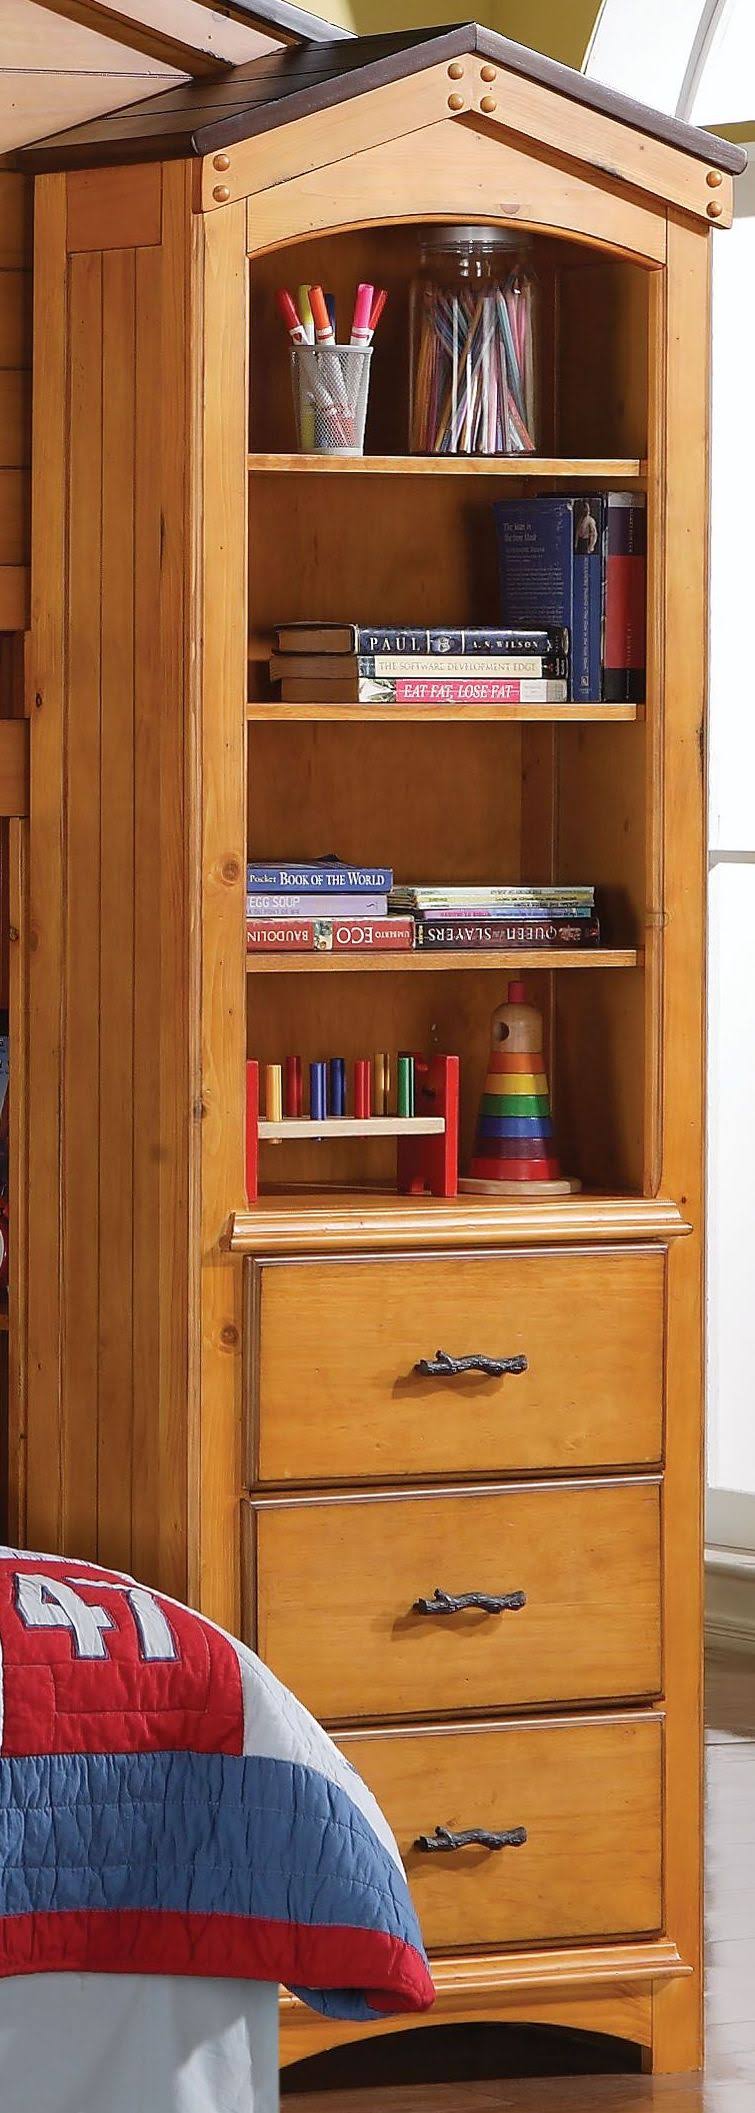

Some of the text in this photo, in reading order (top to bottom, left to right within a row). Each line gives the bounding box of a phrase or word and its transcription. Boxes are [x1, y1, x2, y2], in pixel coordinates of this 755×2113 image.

[369, 637, 421, 651] PAUL
[496, 640, 538, 649] WILSON
[379, 661, 537, 671] THE SOFTWARE DEVELOPMENT EDGE
[403, 684, 427, 698] EAT
[457, 684, 490, 698] LOSE
[490, 684, 514, 698] FAT
[249, 872, 385, 885] Pocket BOOK OF THE WORLD
[249, 896, 300, 908] EGG SOUP
[336, 926, 374, 944] ECO
[428, 927, 492, 941] SLAYERS
[507, 927, 557, 941] QUEEN
[14, 1572, 181, 1662] 47
